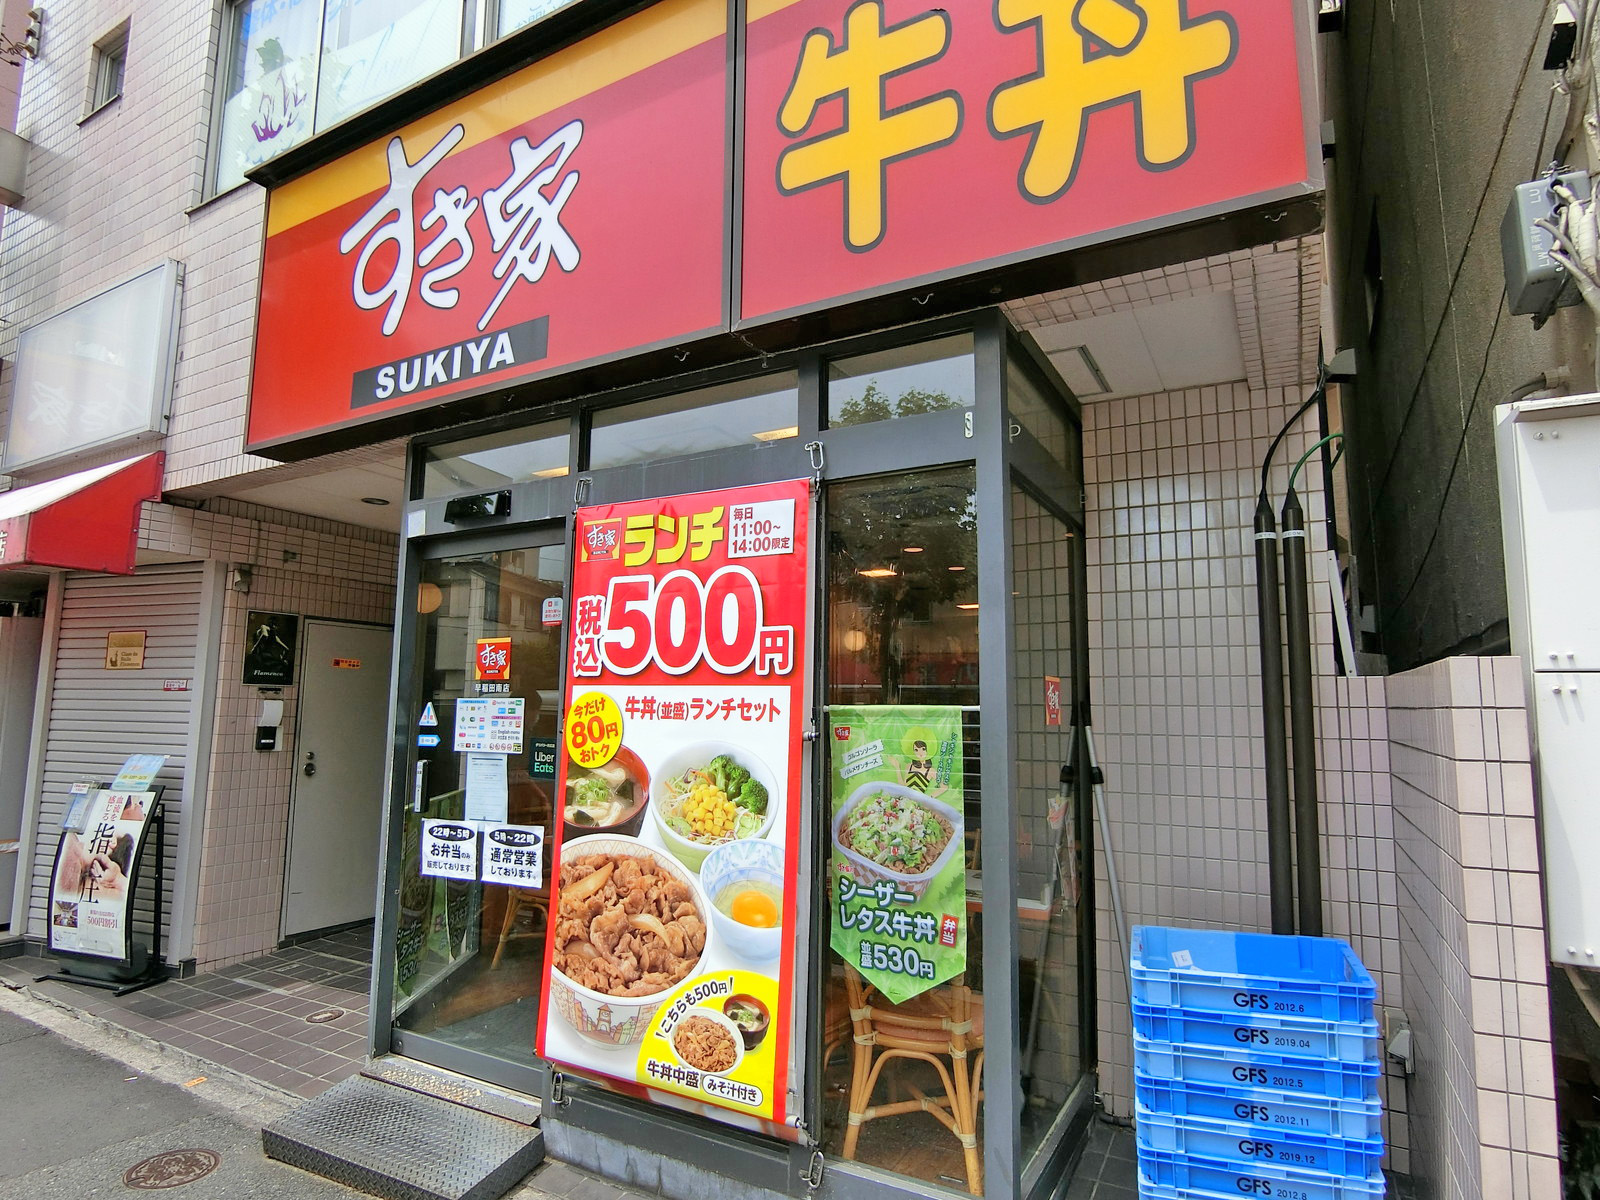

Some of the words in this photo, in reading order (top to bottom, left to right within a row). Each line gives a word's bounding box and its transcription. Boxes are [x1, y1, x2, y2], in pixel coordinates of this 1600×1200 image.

[776, 0, 1238, 253] 牛丼
[340, 119, 584, 336] すき家
[375, 331, 515, 399] SUKIYA
[733, 507, 753, 520] 毎日
[624, 506, 725, 566] ランチ
[732, 537, 790, 554] 14:00限定
[602, 566, 793, 676] 500円
[575, 596, 605, 676] 税込
[480, 643, 507, 669] すき家
[573, 697, 606, 719] 今だけ
[625, 696, 781, 722] 牛丼(並盛)ランチセット
[571, 716, 619, 749] 80円
[535, 752, 555, 762] Uber
[579, 743, 610, 763] おトク
[534, 762, 554, 773] Eats
[431, 843, 471, 859] お弁当のみ
[491, 847, 537, 867] 通常営業
[840, 878, 915, 906] シーザー
[840, 905, 936, 943] レタス牛丼
[942, 918, 956, 945] 弁当
[861, 941, 873, 968] 並盛
[873, 944, 934, 978] 530円
[1233, 992, 1269, 1009] GFS
[1274, 1003, 1304, 1012] 2012.6
[1233, 1027, 1269, 1044] GFS
[1274, 1038, 1310, 1048] 2019.04
[647, 1060, 700, 1089] 牛丼中盛
[1232, 1066, 1268, 1084] GFS
[1273, 1077, 1303, 1087] 2012.5
[707, 1079, 757, 1102] みそ汁付き
[1234, 1103, 1269, 1121] GFS
[1274, 1115, 1309, 1126] 2012.11
[1238, 1140, 1274, 1158] GFS
[1279, 1152, 1315, 1163] 2019.12
[1236, 1177, 1272, 1195] GFS
[1277, 1189, 1307, 1200] 2012.8
